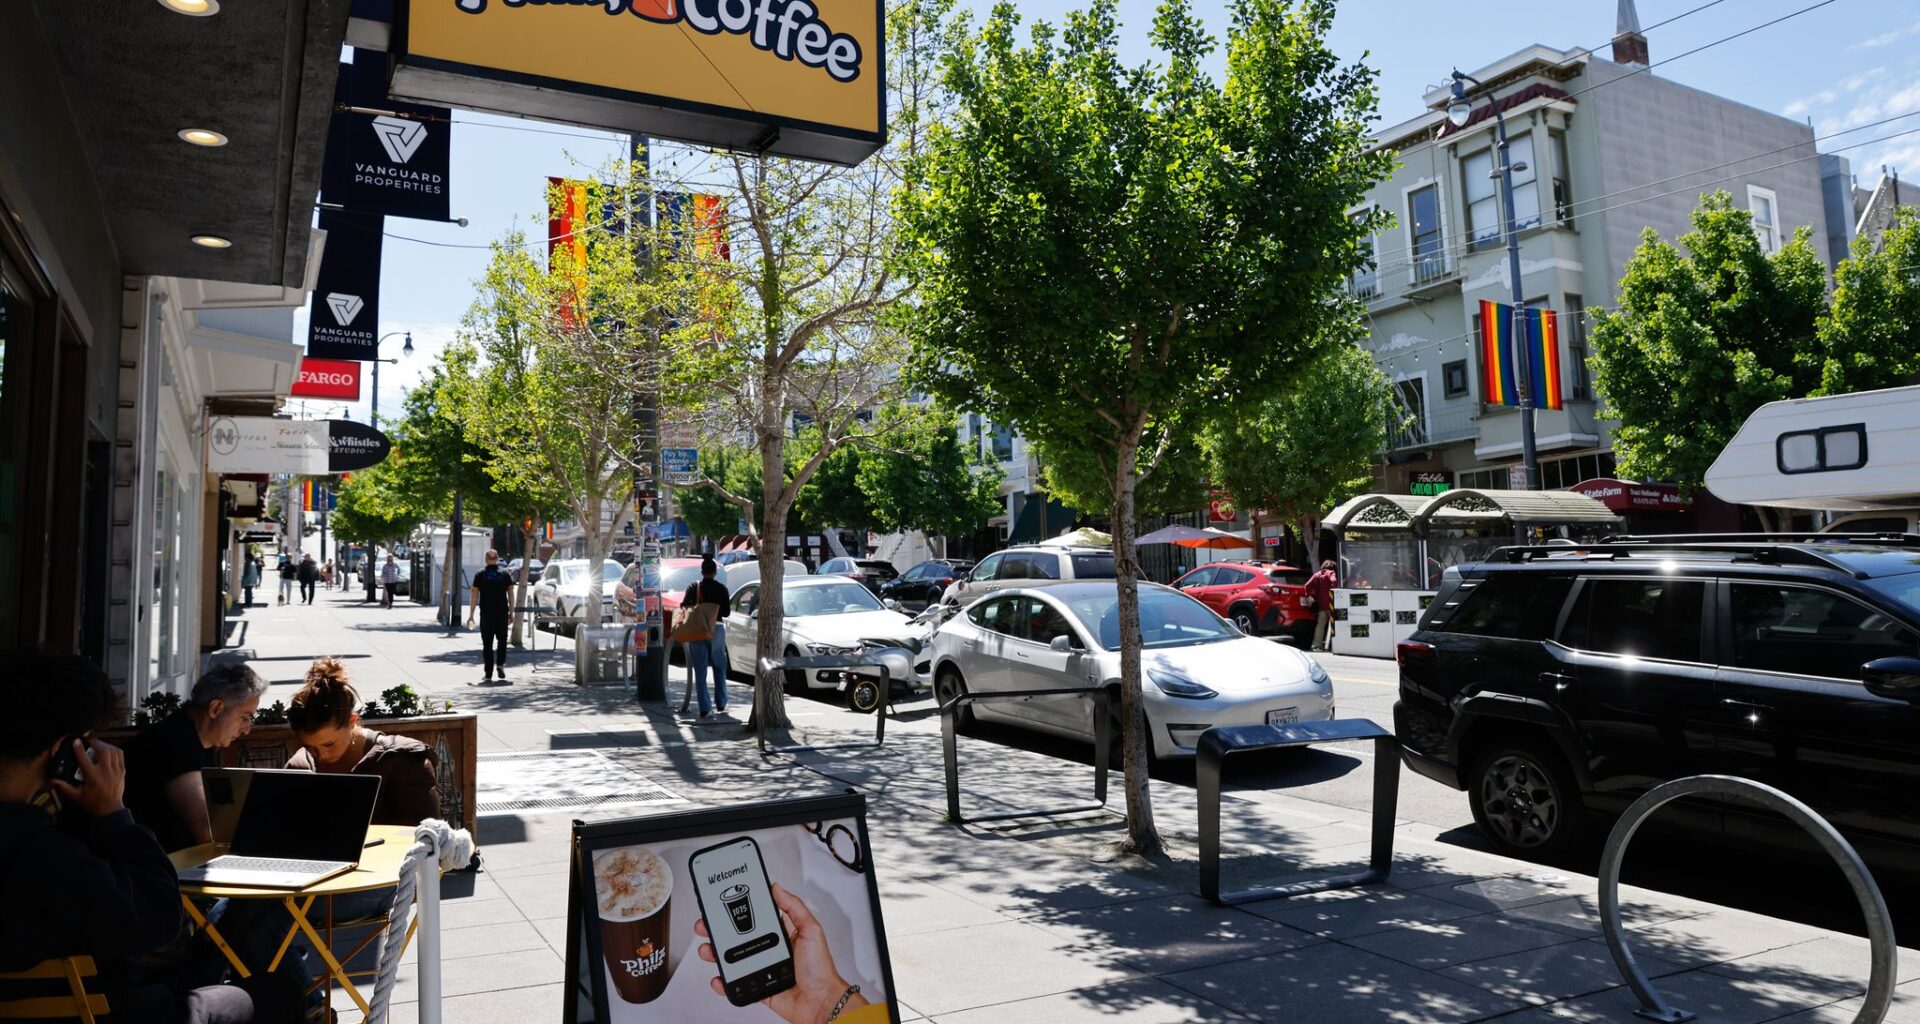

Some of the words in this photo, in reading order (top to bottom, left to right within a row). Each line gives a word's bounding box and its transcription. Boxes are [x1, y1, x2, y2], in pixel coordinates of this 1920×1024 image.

[684, 0, 858, 79] Coffee
[355, 162, 442, 183] VANGUARD
[355, 174, 442, 194] PROPERTIES
[314, 326, 373, 339] VANGUARD
[314, 334, 373, 346] PROPERTIES
[300, 371, 354, 386] FARGO
[663, 450, 677, 458] Pay
[678, 450, 688, 459] by
[707, 863, 749, 885] Welcome!
[732, 904, 748, 917] 1075
[620, 946, 666, 973] Philz
[631, 959, 664, 977] Coffee
